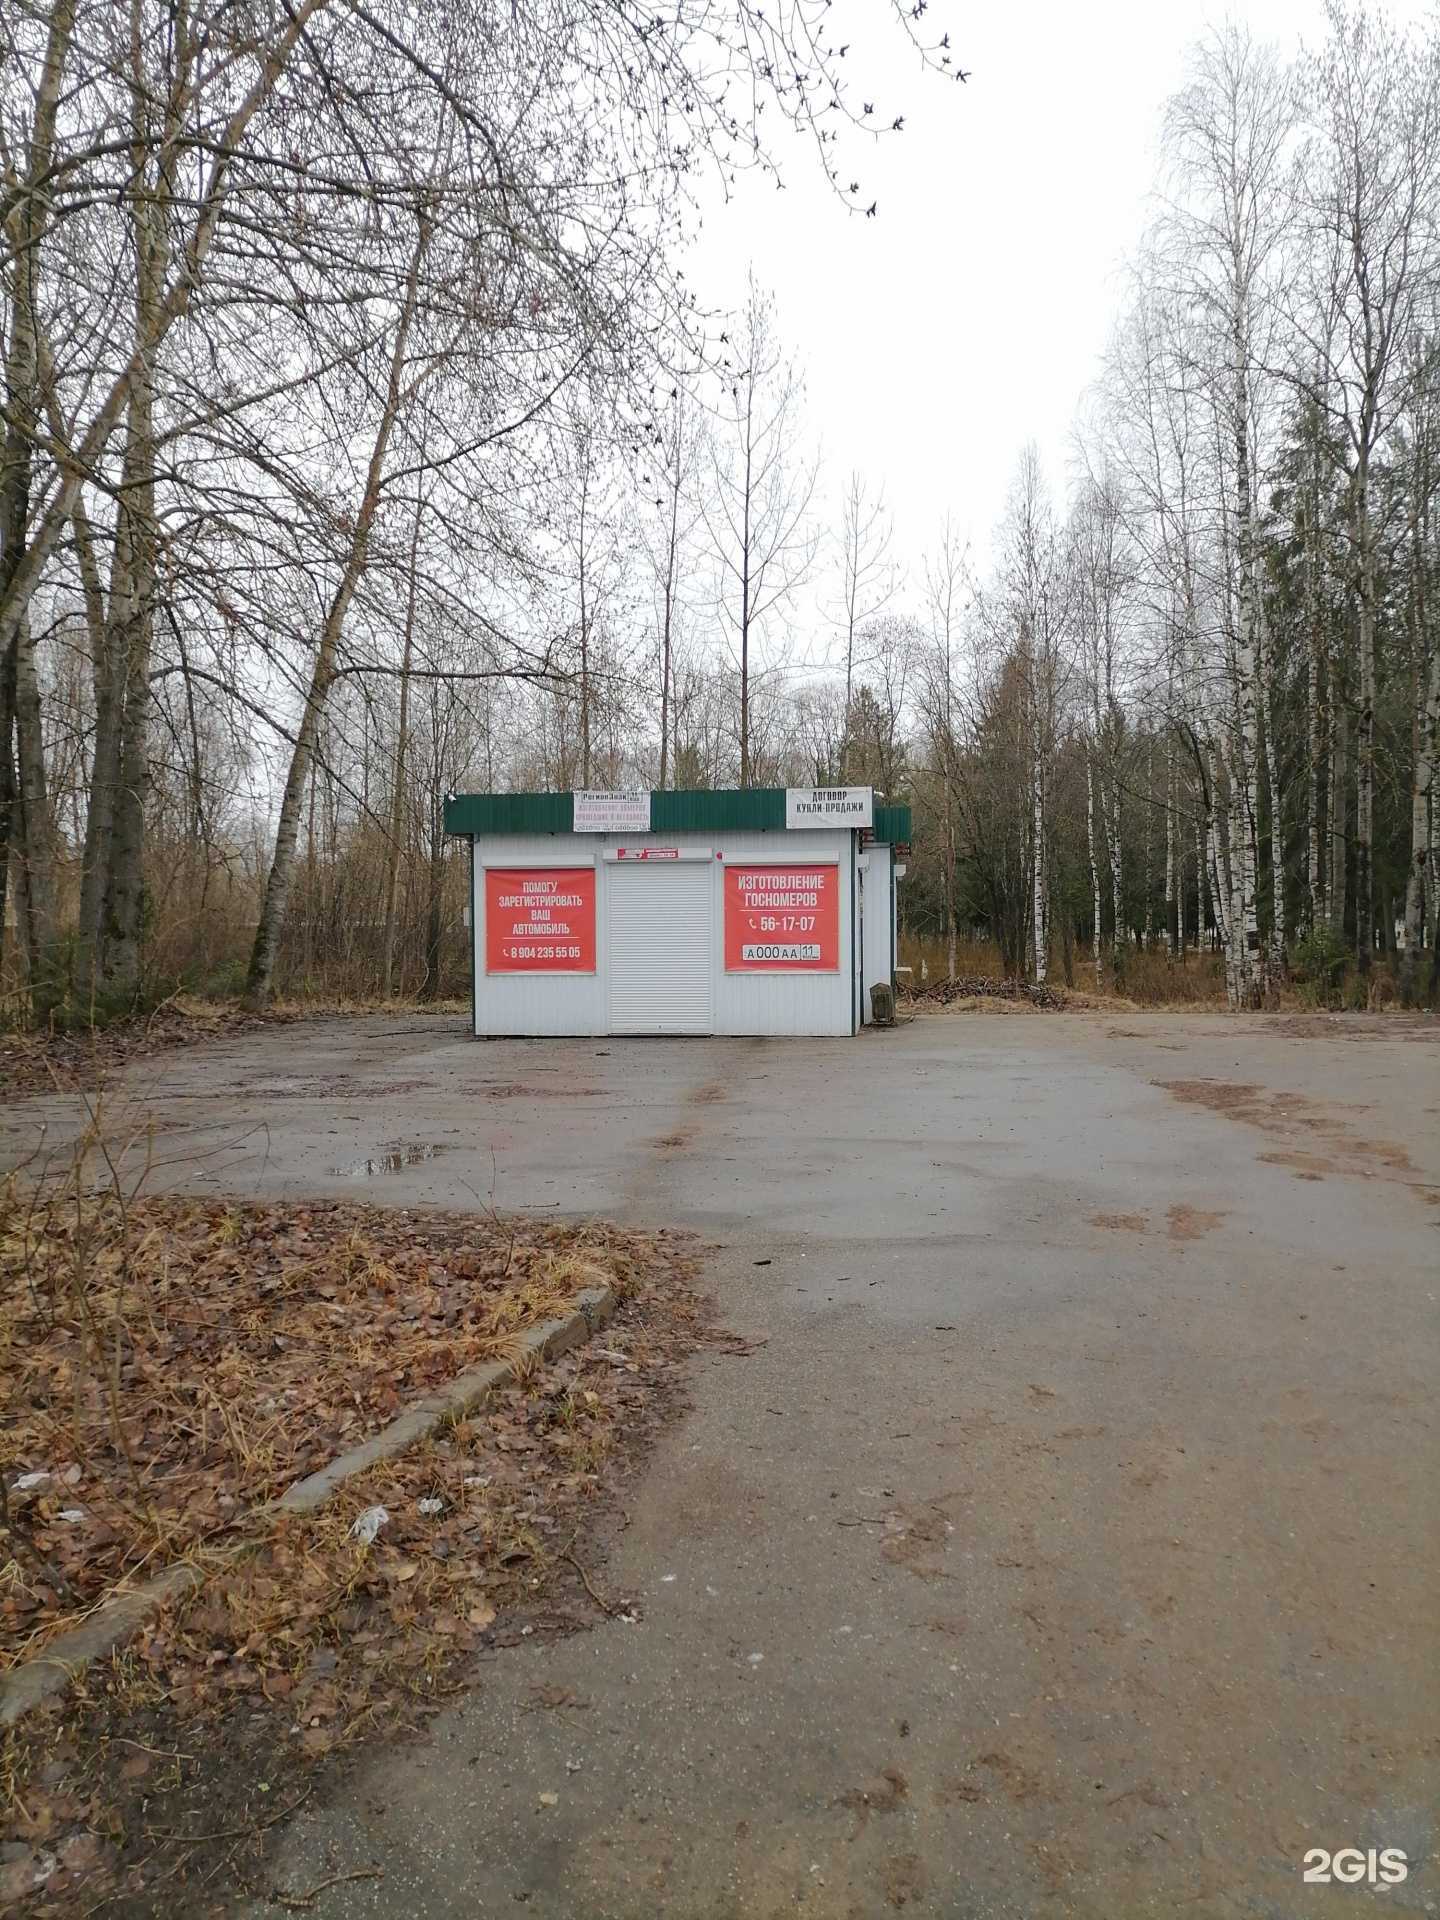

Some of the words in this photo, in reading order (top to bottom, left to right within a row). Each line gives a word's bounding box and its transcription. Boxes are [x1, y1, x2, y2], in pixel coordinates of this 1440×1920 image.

[812, 791, 848, 802] ДОГОВОР
[796, 802, 864, 813] КУПЛИ-ПРОДАЖИ
[523, 881, 558, 893] ПОМОГУ
[738, 875, 825, 890] ИЗГОТОВЛЕНИЕ
[498, 895, 583, 907] ЗАРЕГИСТРИРОВАТЬ
[745, 892, 818, 907] ГОСНОМЕРОВ
[531, 909, 551, 921] ВАШ
[512, 923, 570, 935] АВТОМОБИЛЬ
[760, 916, 816, 931] 56-17-07
[511, 946, 517, 958] 8
[518, 946, 536, 958] 904
[537, 946, 554, 958] 235
[555, 946, 567, 958] 55
[568, 946, 581, 958] 05
